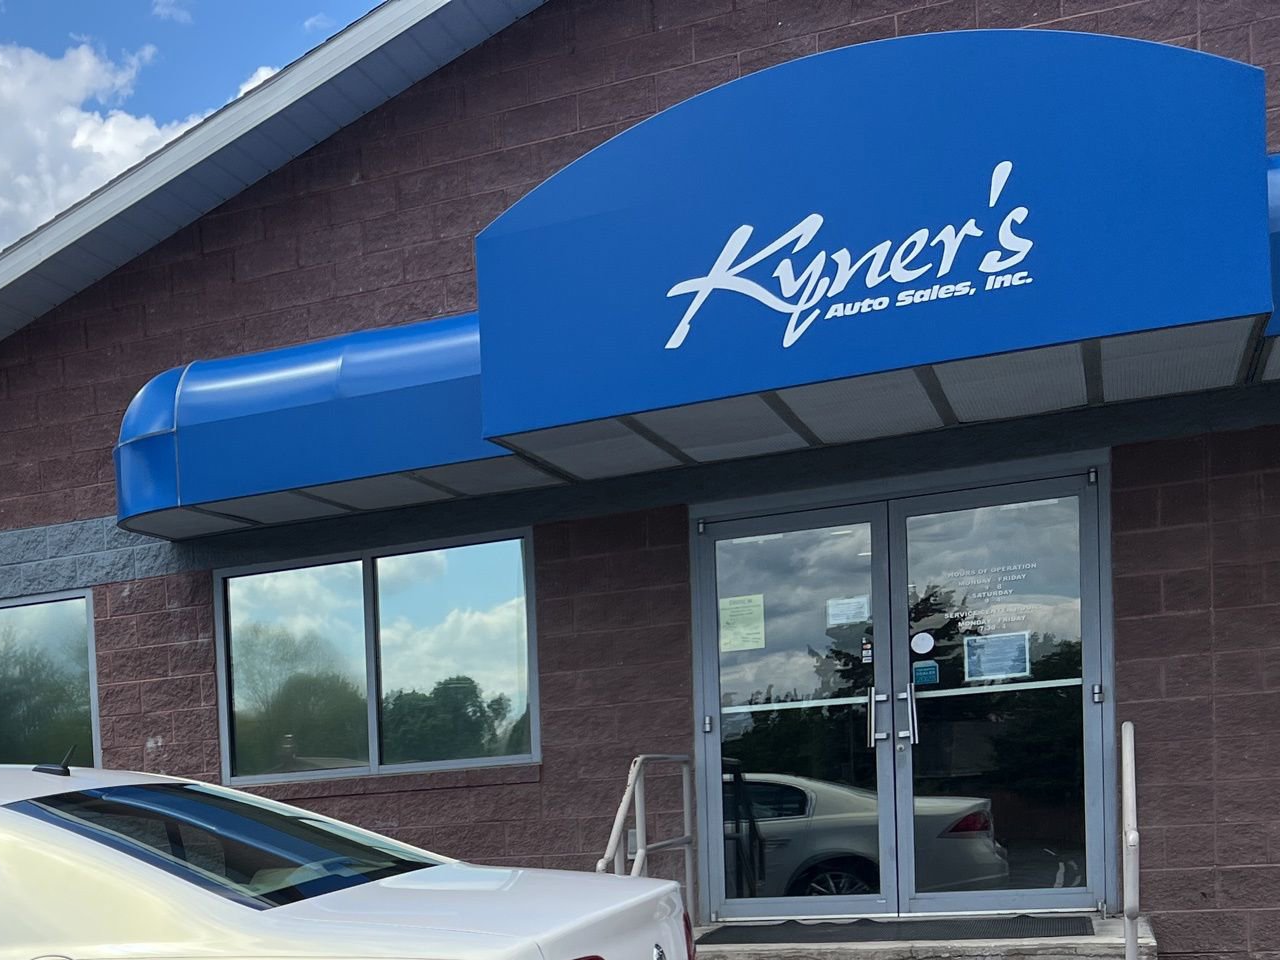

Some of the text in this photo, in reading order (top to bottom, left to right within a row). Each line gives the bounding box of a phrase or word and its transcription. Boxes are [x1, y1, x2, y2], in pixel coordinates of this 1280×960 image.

[664, 160, 1034, 349] Kyner's
[824, 271, 1033, 320] Auto Sales, Inc.
[947, 562, 1037, 578] HOURS OF OPERATION
[958, 574, 1026, 586] MONDAY FRIDAY
[971, 589, 1014, 599] SATURDAY
[944, 610, 977, 619] SERVICE
[957, 615, 1026, 628] MONDAY FRIDAY
